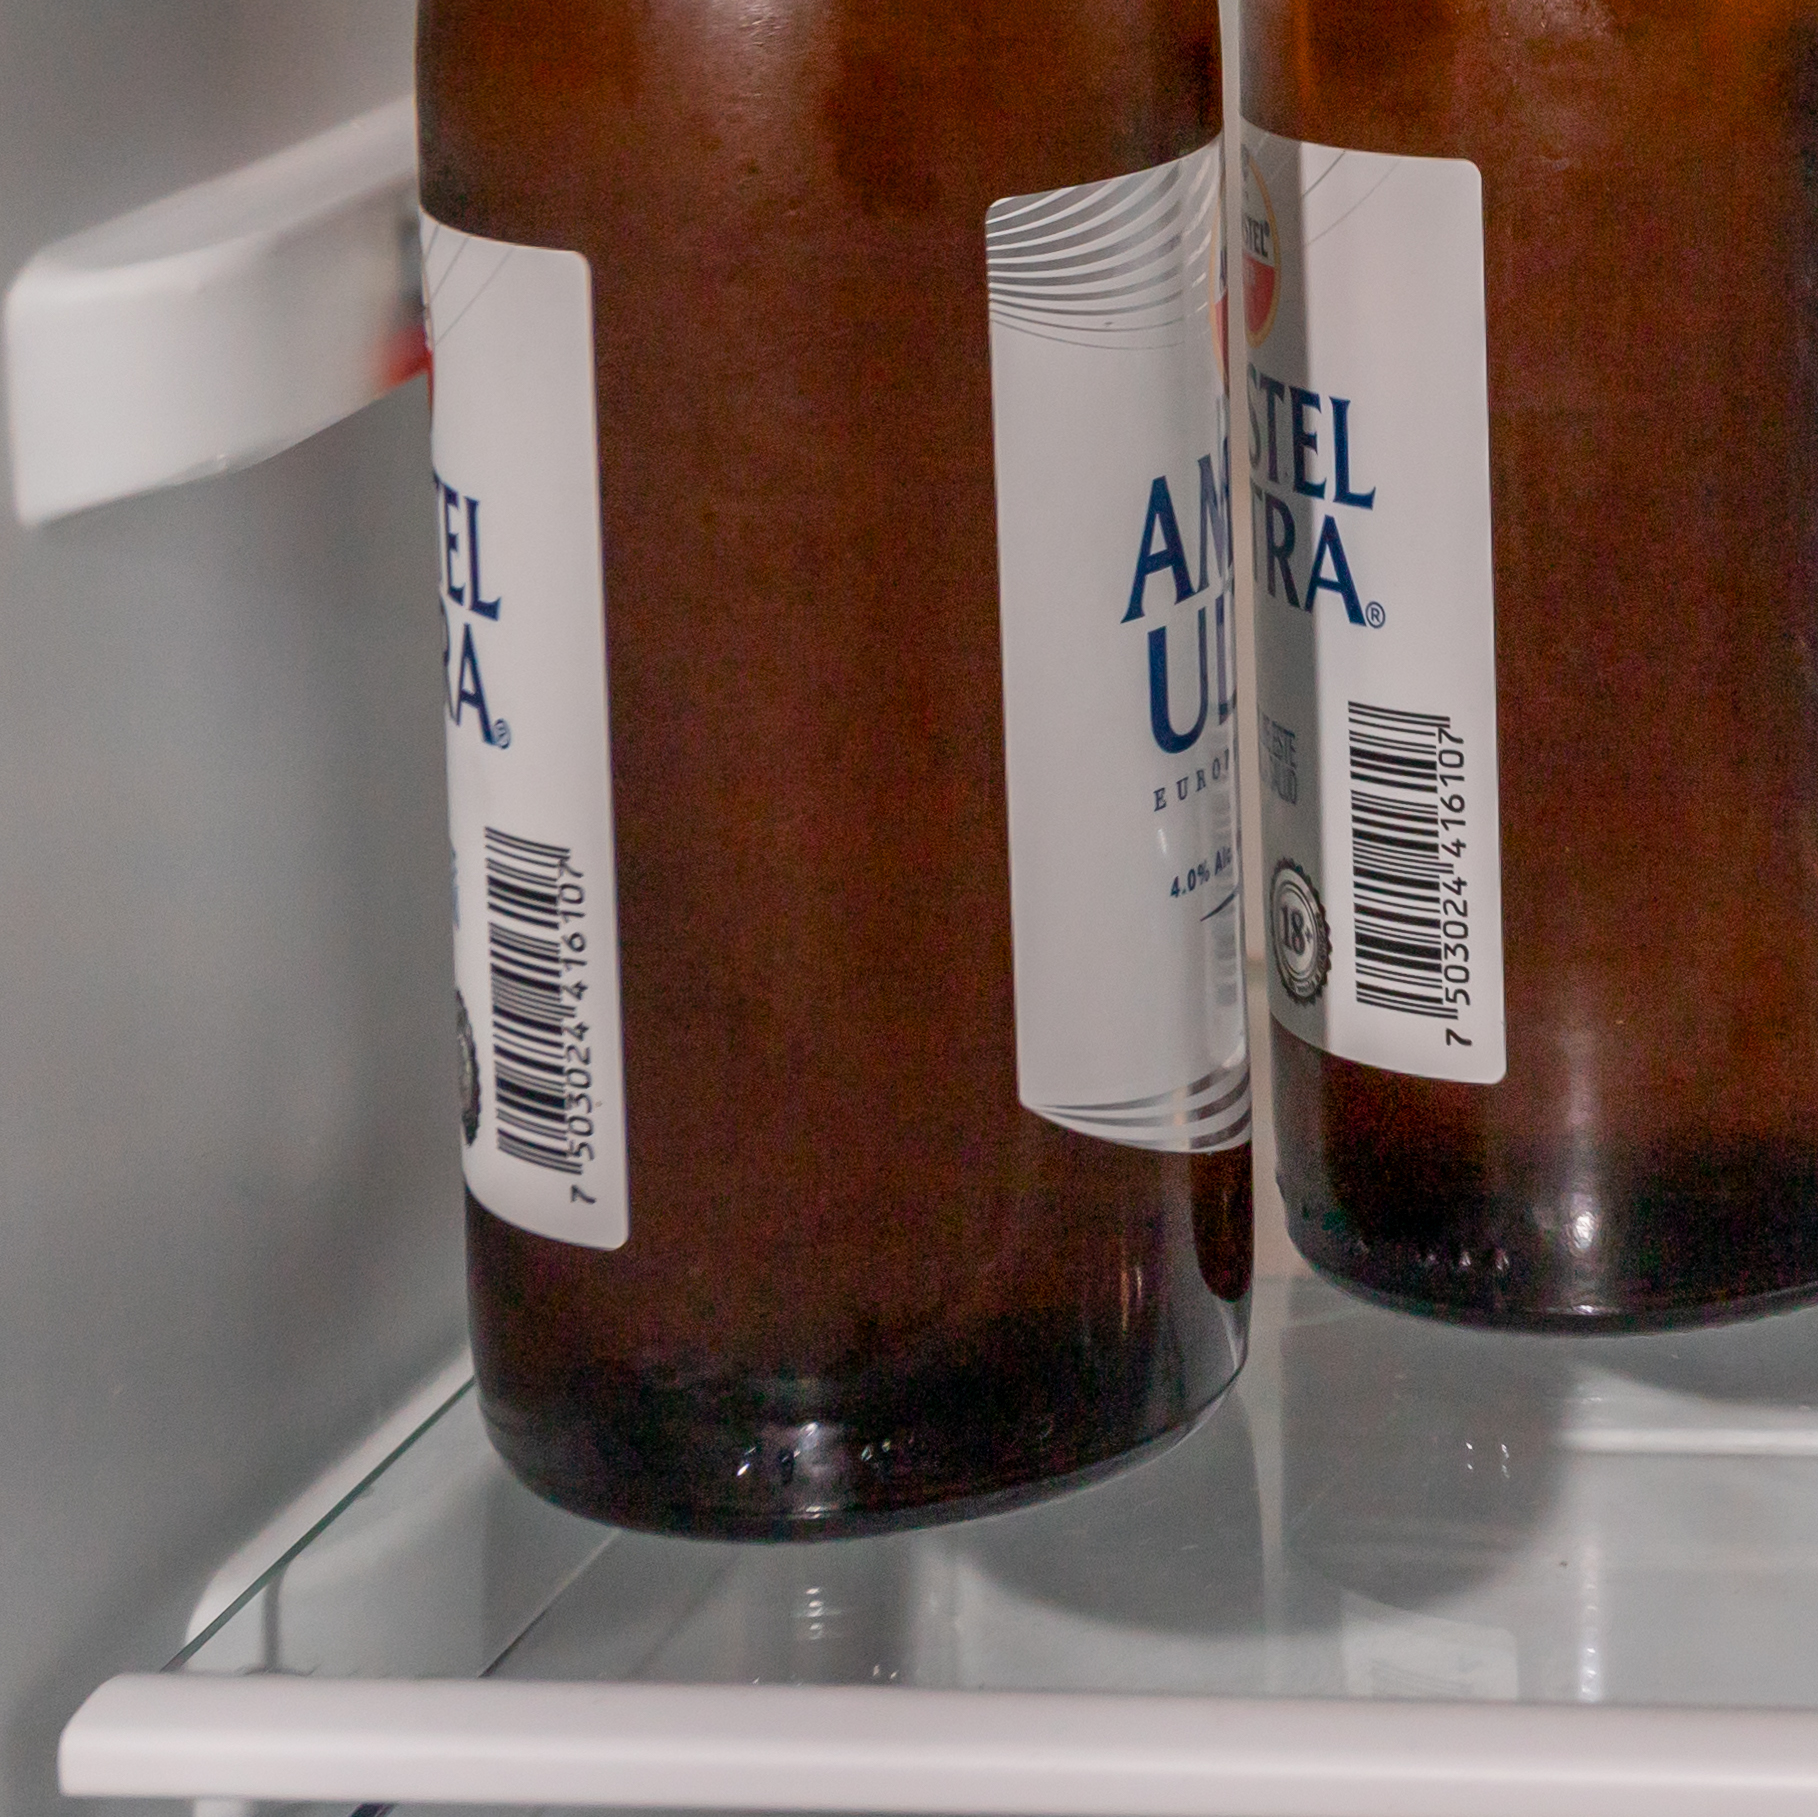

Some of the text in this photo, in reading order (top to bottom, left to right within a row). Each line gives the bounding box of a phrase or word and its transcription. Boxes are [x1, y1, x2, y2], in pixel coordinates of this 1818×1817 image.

[556, 857, 597, 1205] 7 503024 416107
[1170, 860, 1211, 899] 4.0%
[1437, 727, 1473, 1047] 7 503024 416107
